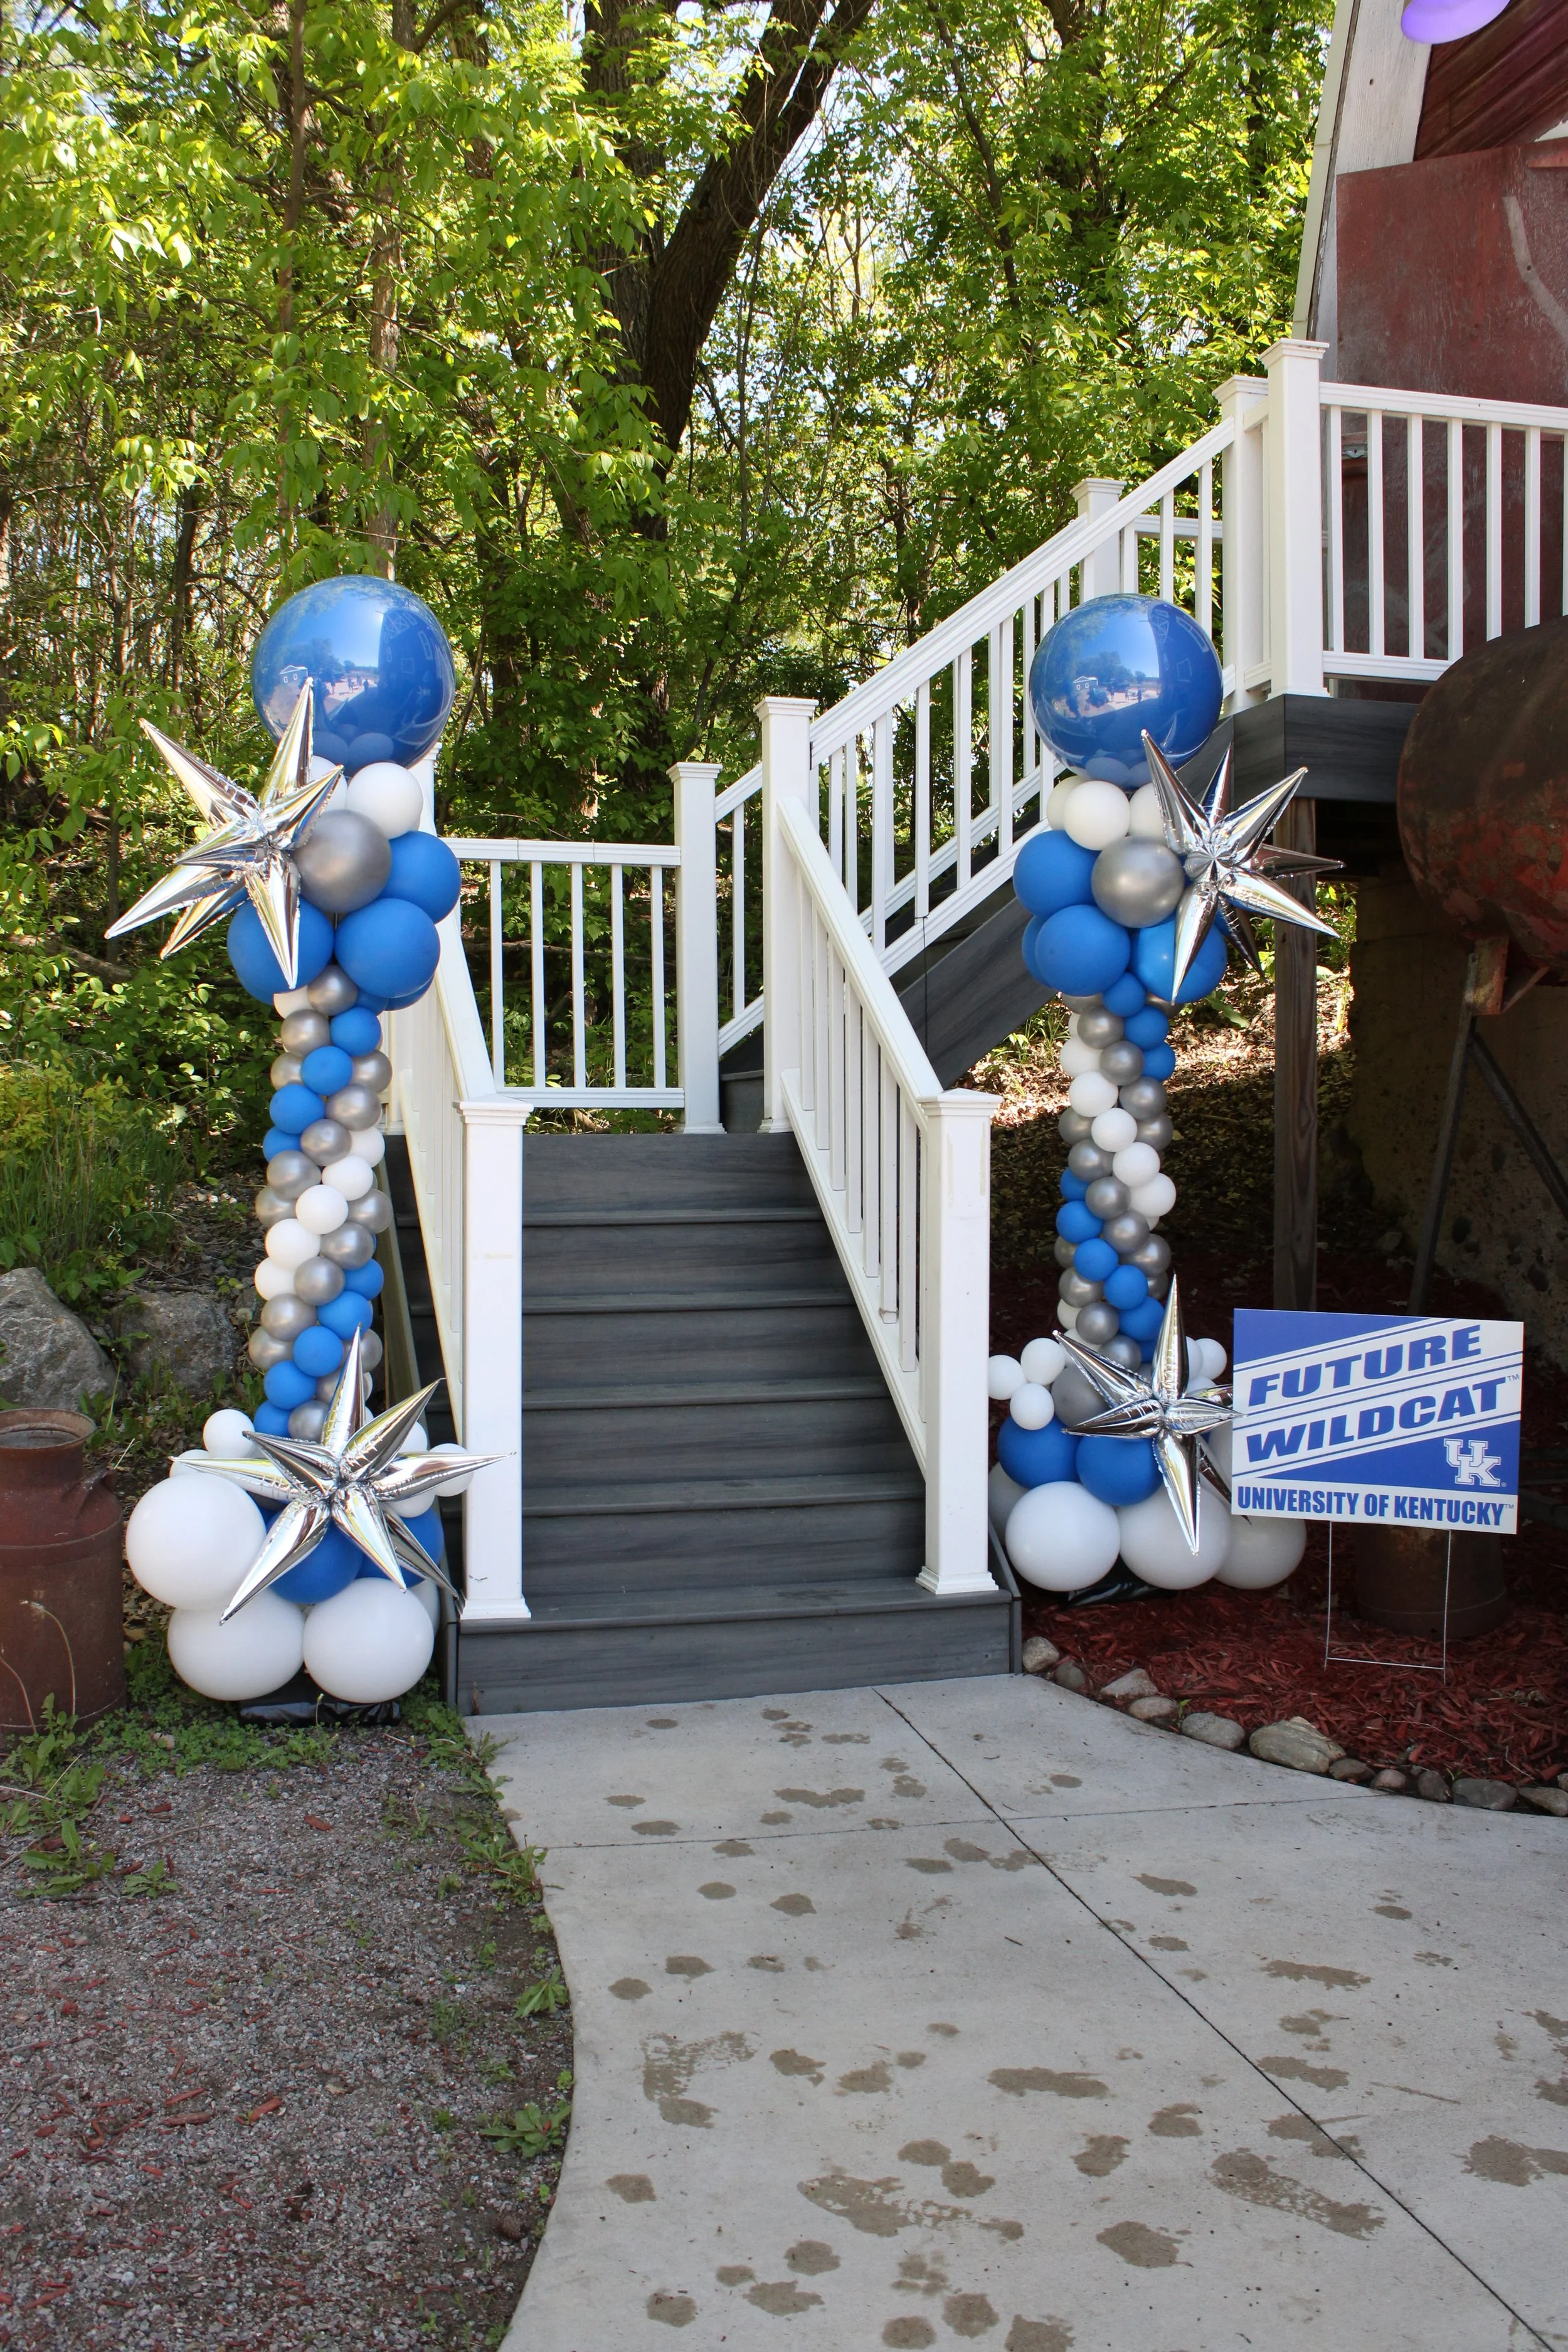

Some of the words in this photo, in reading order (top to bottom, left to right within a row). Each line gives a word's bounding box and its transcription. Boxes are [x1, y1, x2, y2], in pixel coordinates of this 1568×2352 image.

[1248, 1324, 1481, 1407] FUTURE
[1246, 1376, 1507, 1463] WILDCAT
[1444, 1438, 1502, 1487] UK
[1237, 1486, 1360, 1515] UNIVERSITY
[1364, 1493, 1390, 1517] OF
[1394, 1495, 1505, 1526] KENTUCKY
